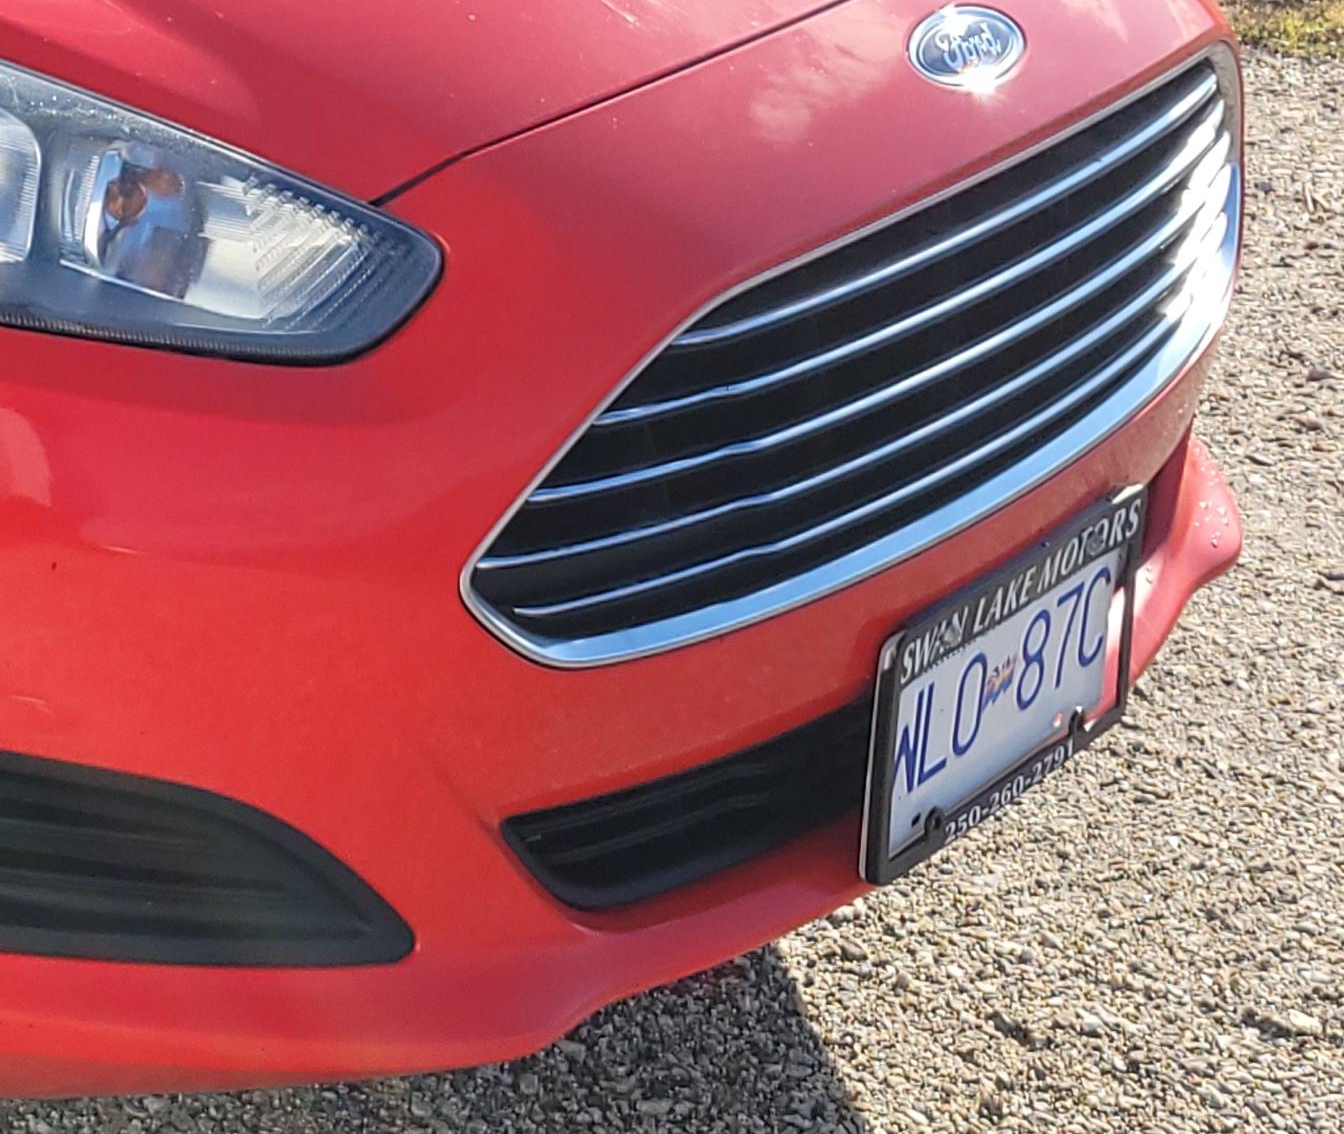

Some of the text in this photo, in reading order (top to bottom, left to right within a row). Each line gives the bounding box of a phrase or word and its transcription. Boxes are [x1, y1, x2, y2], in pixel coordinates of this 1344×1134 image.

[934, 21, 1002, 71] Ford
[973, 566, 1036, 634] LAKE
[1037, 498, 1142, 593] MOTORS
[944, 738, 1074, 845] 250-260-2791
